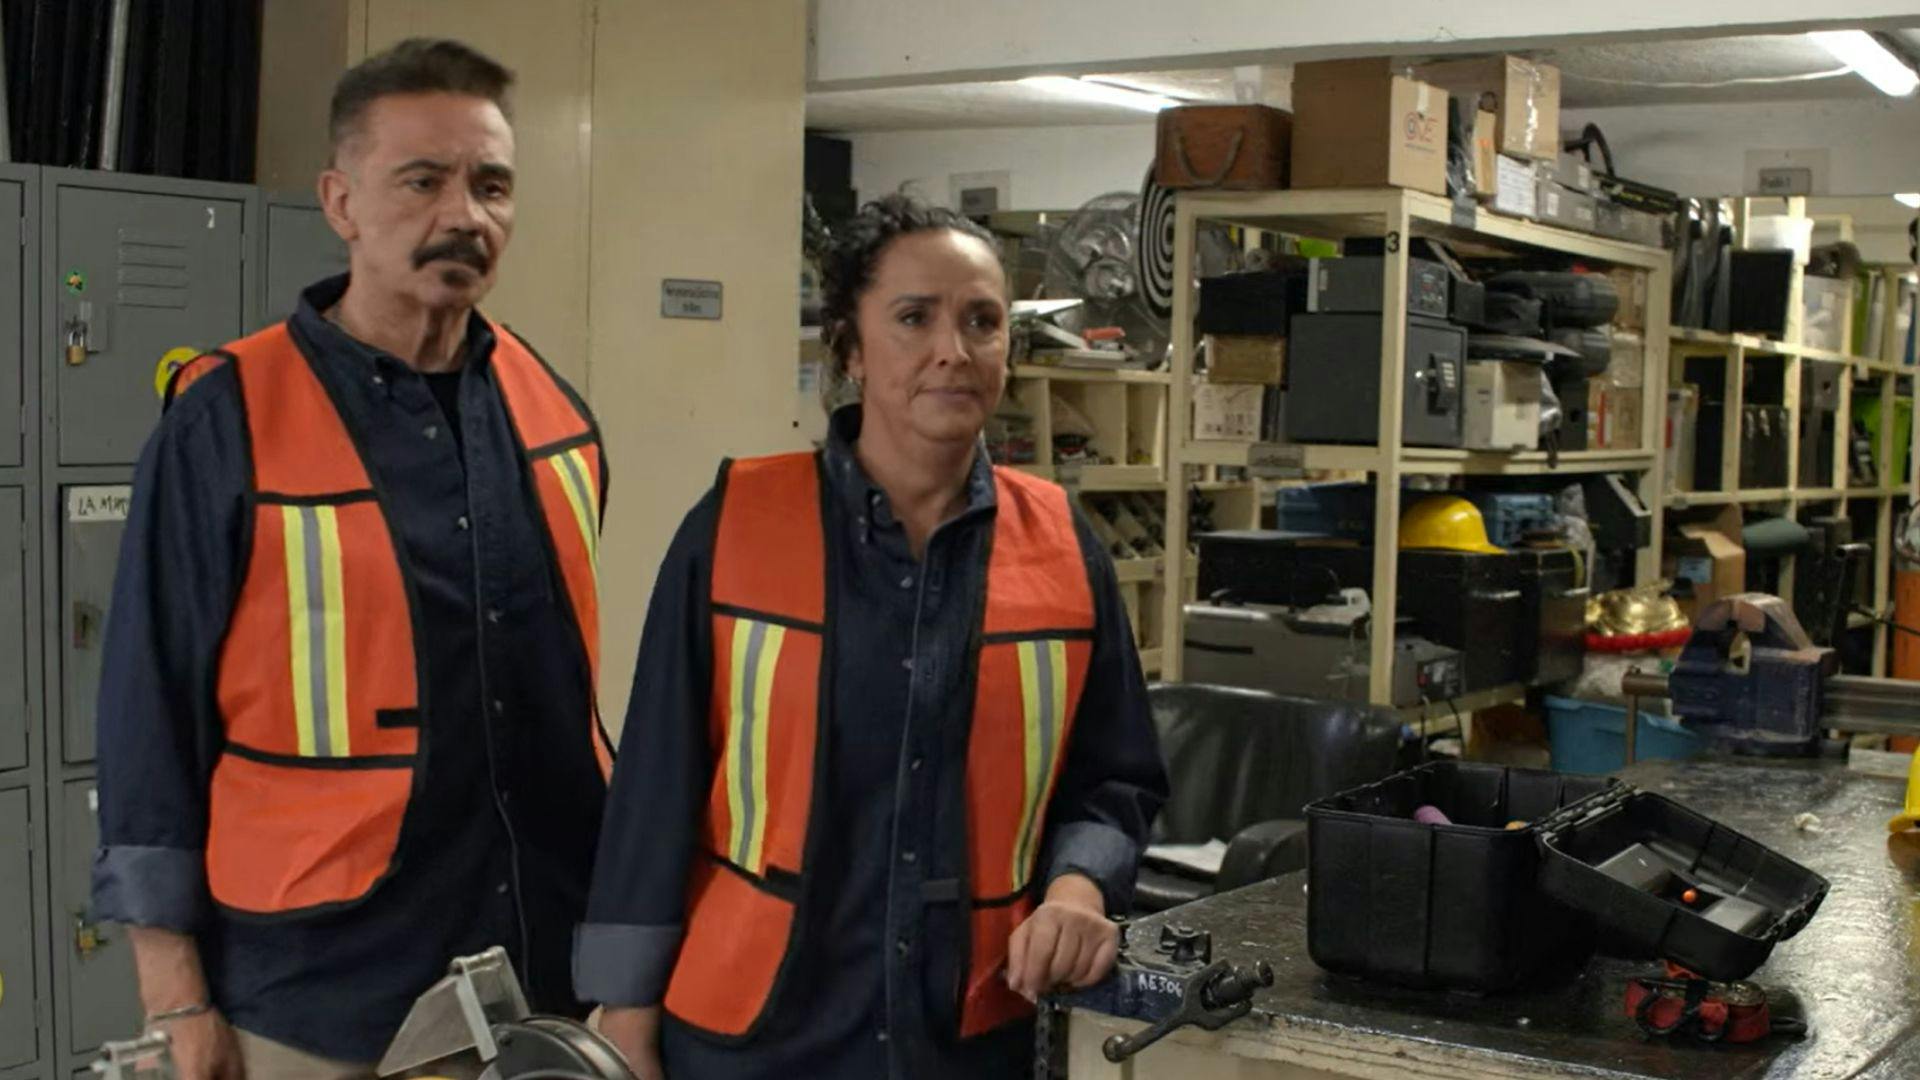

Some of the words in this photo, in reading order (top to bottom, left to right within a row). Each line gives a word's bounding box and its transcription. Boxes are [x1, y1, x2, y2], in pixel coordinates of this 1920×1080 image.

[1387, 230, 1400, 254] 3
[78, 495, 97, 516] LA
[1138, 972, 1183, 998] AE306
